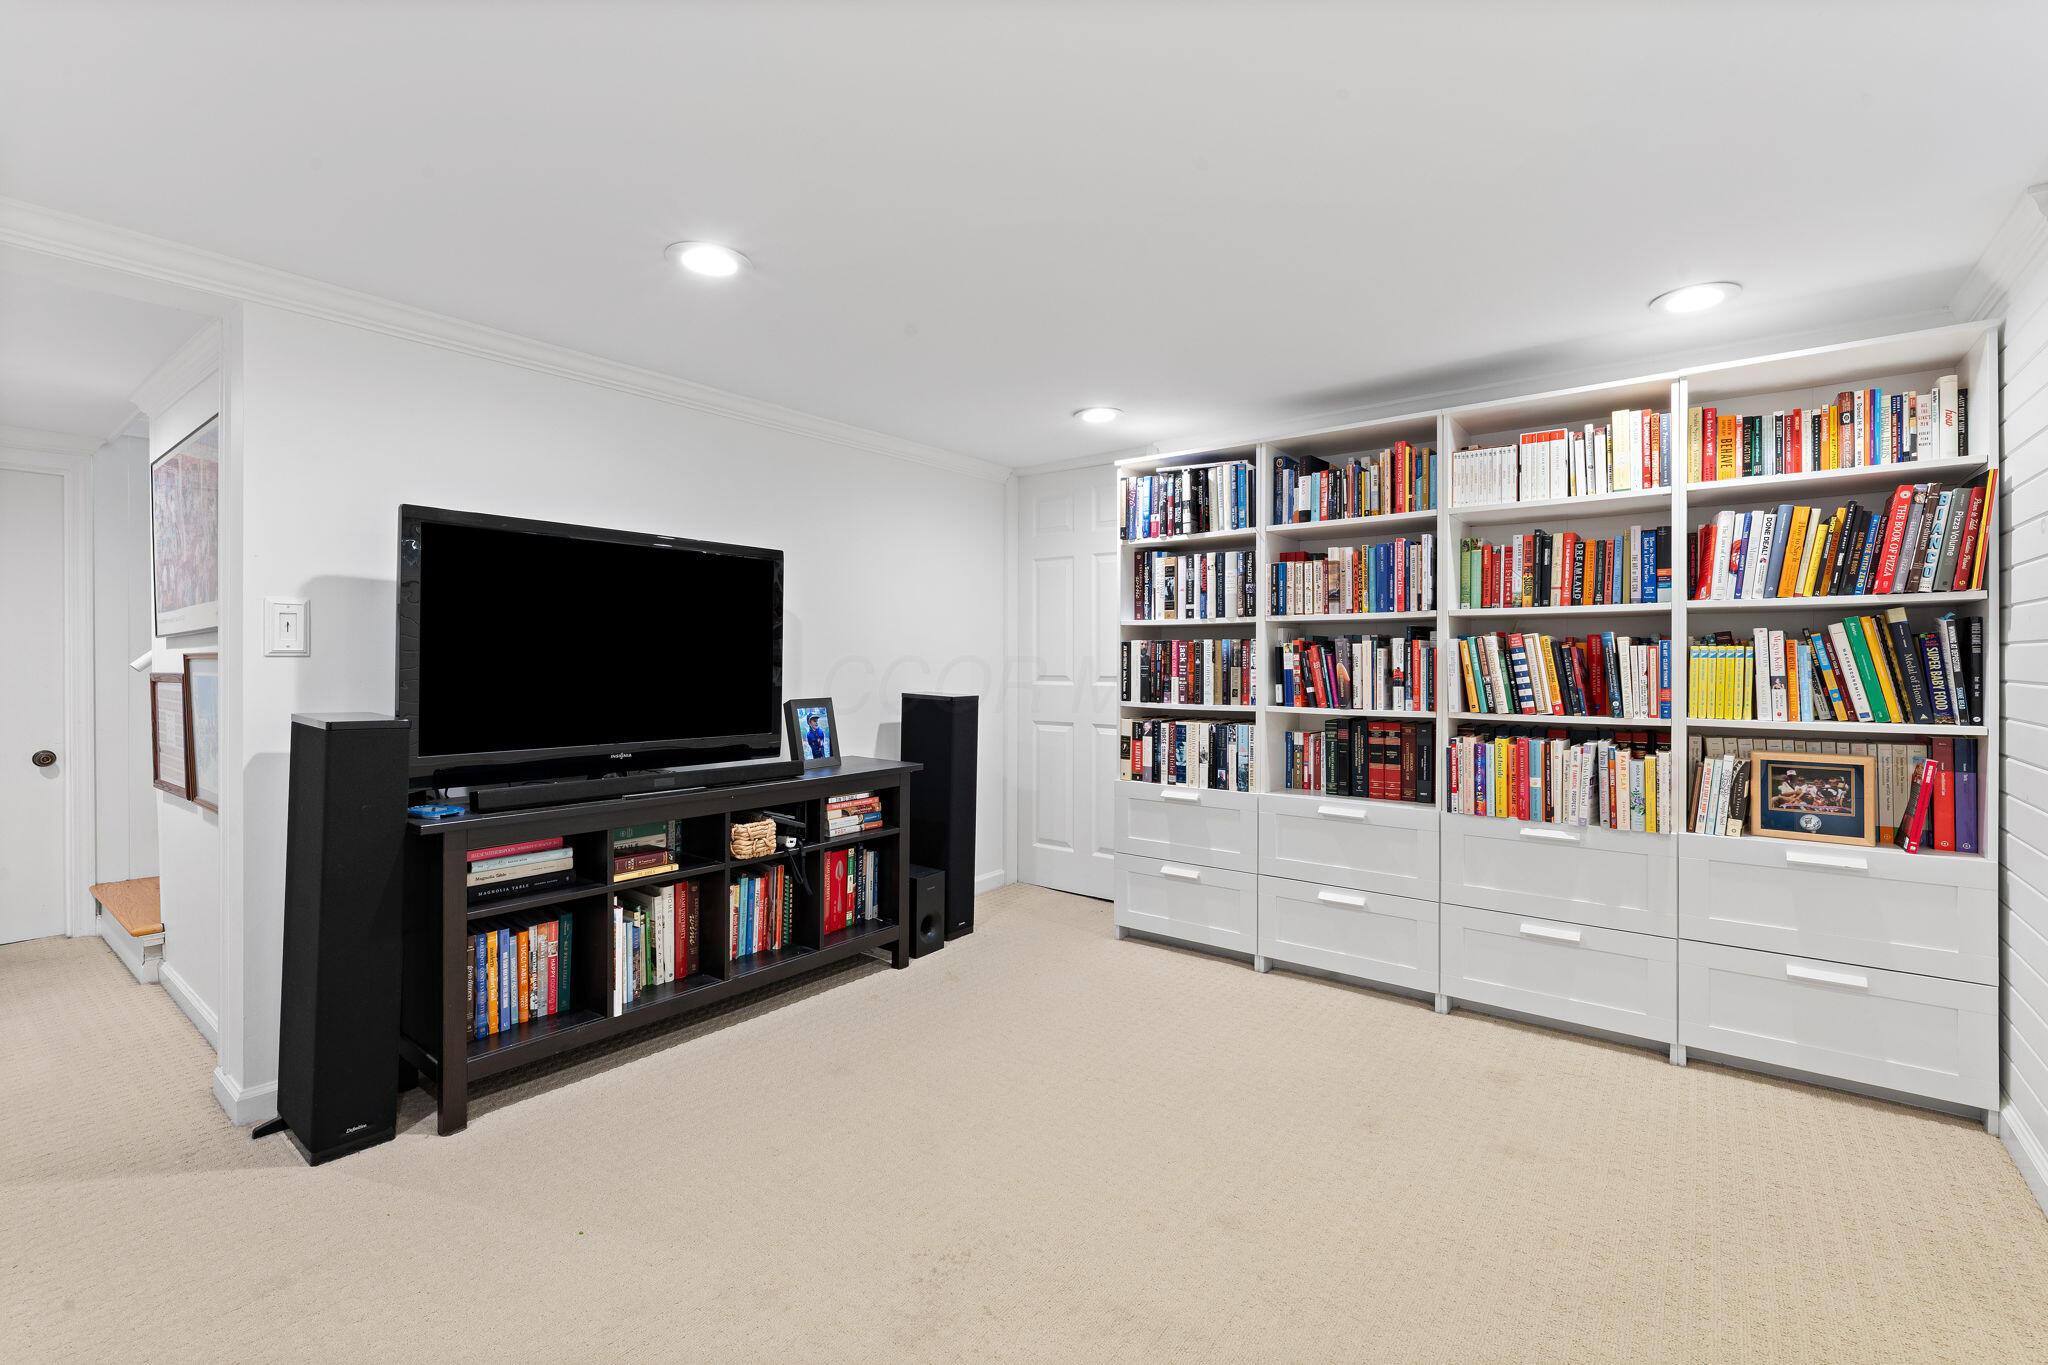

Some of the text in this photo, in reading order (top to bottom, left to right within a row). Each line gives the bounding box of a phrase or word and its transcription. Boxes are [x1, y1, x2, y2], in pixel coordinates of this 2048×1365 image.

[1945, 410, 1956, 426] how
[1721, 439, 1732, 468] BEHAVE
[1761, 517, 1772, 556] DONE DEAL!
[1856, 532, 1864, 551] BEATING
[1883, 504, 1907, 577] THE BOOK OF PIZZA
[1919, 529, 1931, 550] dinners
[1923, 493, 1950, 578] BIANCO
[1947, 511, 1963, 556] Pizza Volume
[1792, 546, 1801, 556] Say
[1856, 544, 1872, 587] DIE WITH ZERO
[1574, 544, 1583, 599] DREAMLAND
[1718, 556, 1726, 584] Connection
[1849, 561, 1859, 575] BOOKS
[1948, 626, 1957, 643] WINNING
[1773, 635, 1782, 672] Megyn Kelly
[1950, 649, 1960, 672] DEPOSITION
[1489, 650, 1501, 698] Atomic Habits
[1842, 649, 1861, 701] MACROECONOMICS
[1904, 653, 1914, 675] Medal
[1911, 684, 1922, 707] Honor
[1926, 647, 1947, 710] SUPER BABY FOOD
[1956, 687, 1964, 699] SHANE
[478, 888, 509, 896] MAGNOLIA
